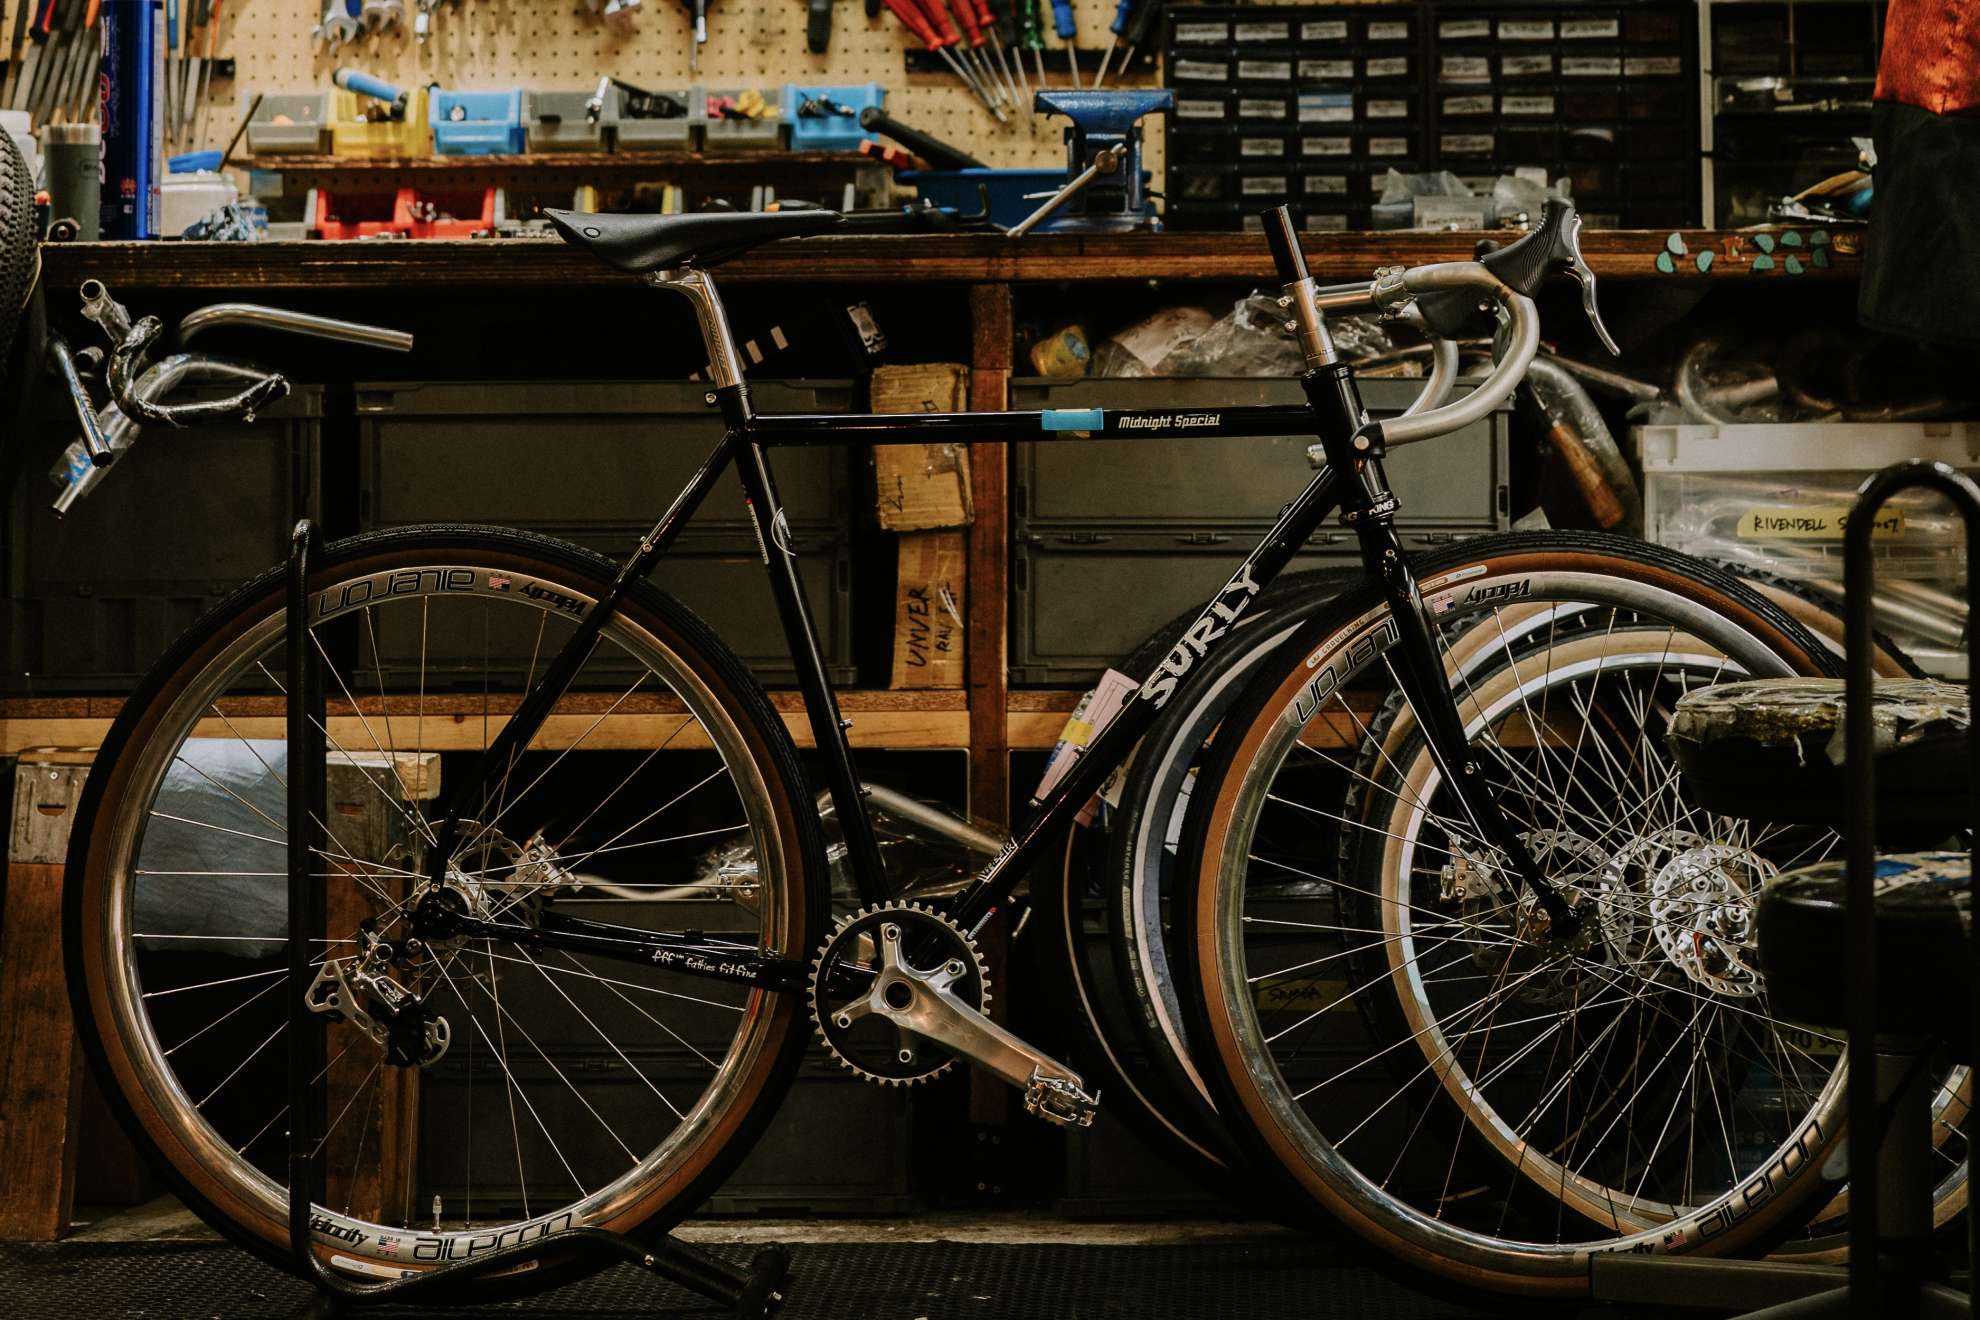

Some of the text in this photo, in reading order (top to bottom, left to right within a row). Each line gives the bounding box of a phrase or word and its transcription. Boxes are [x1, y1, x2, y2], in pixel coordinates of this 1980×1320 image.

[1118, 413, 1221, 431] Midnight Special
[1753, 514, 1827, 532] RIVENDELL
[518, 580, 587, 616] Velocity
[1463, 578, 1533, 606] Velocity
[1140, 562, 1260, 710] SURLY
